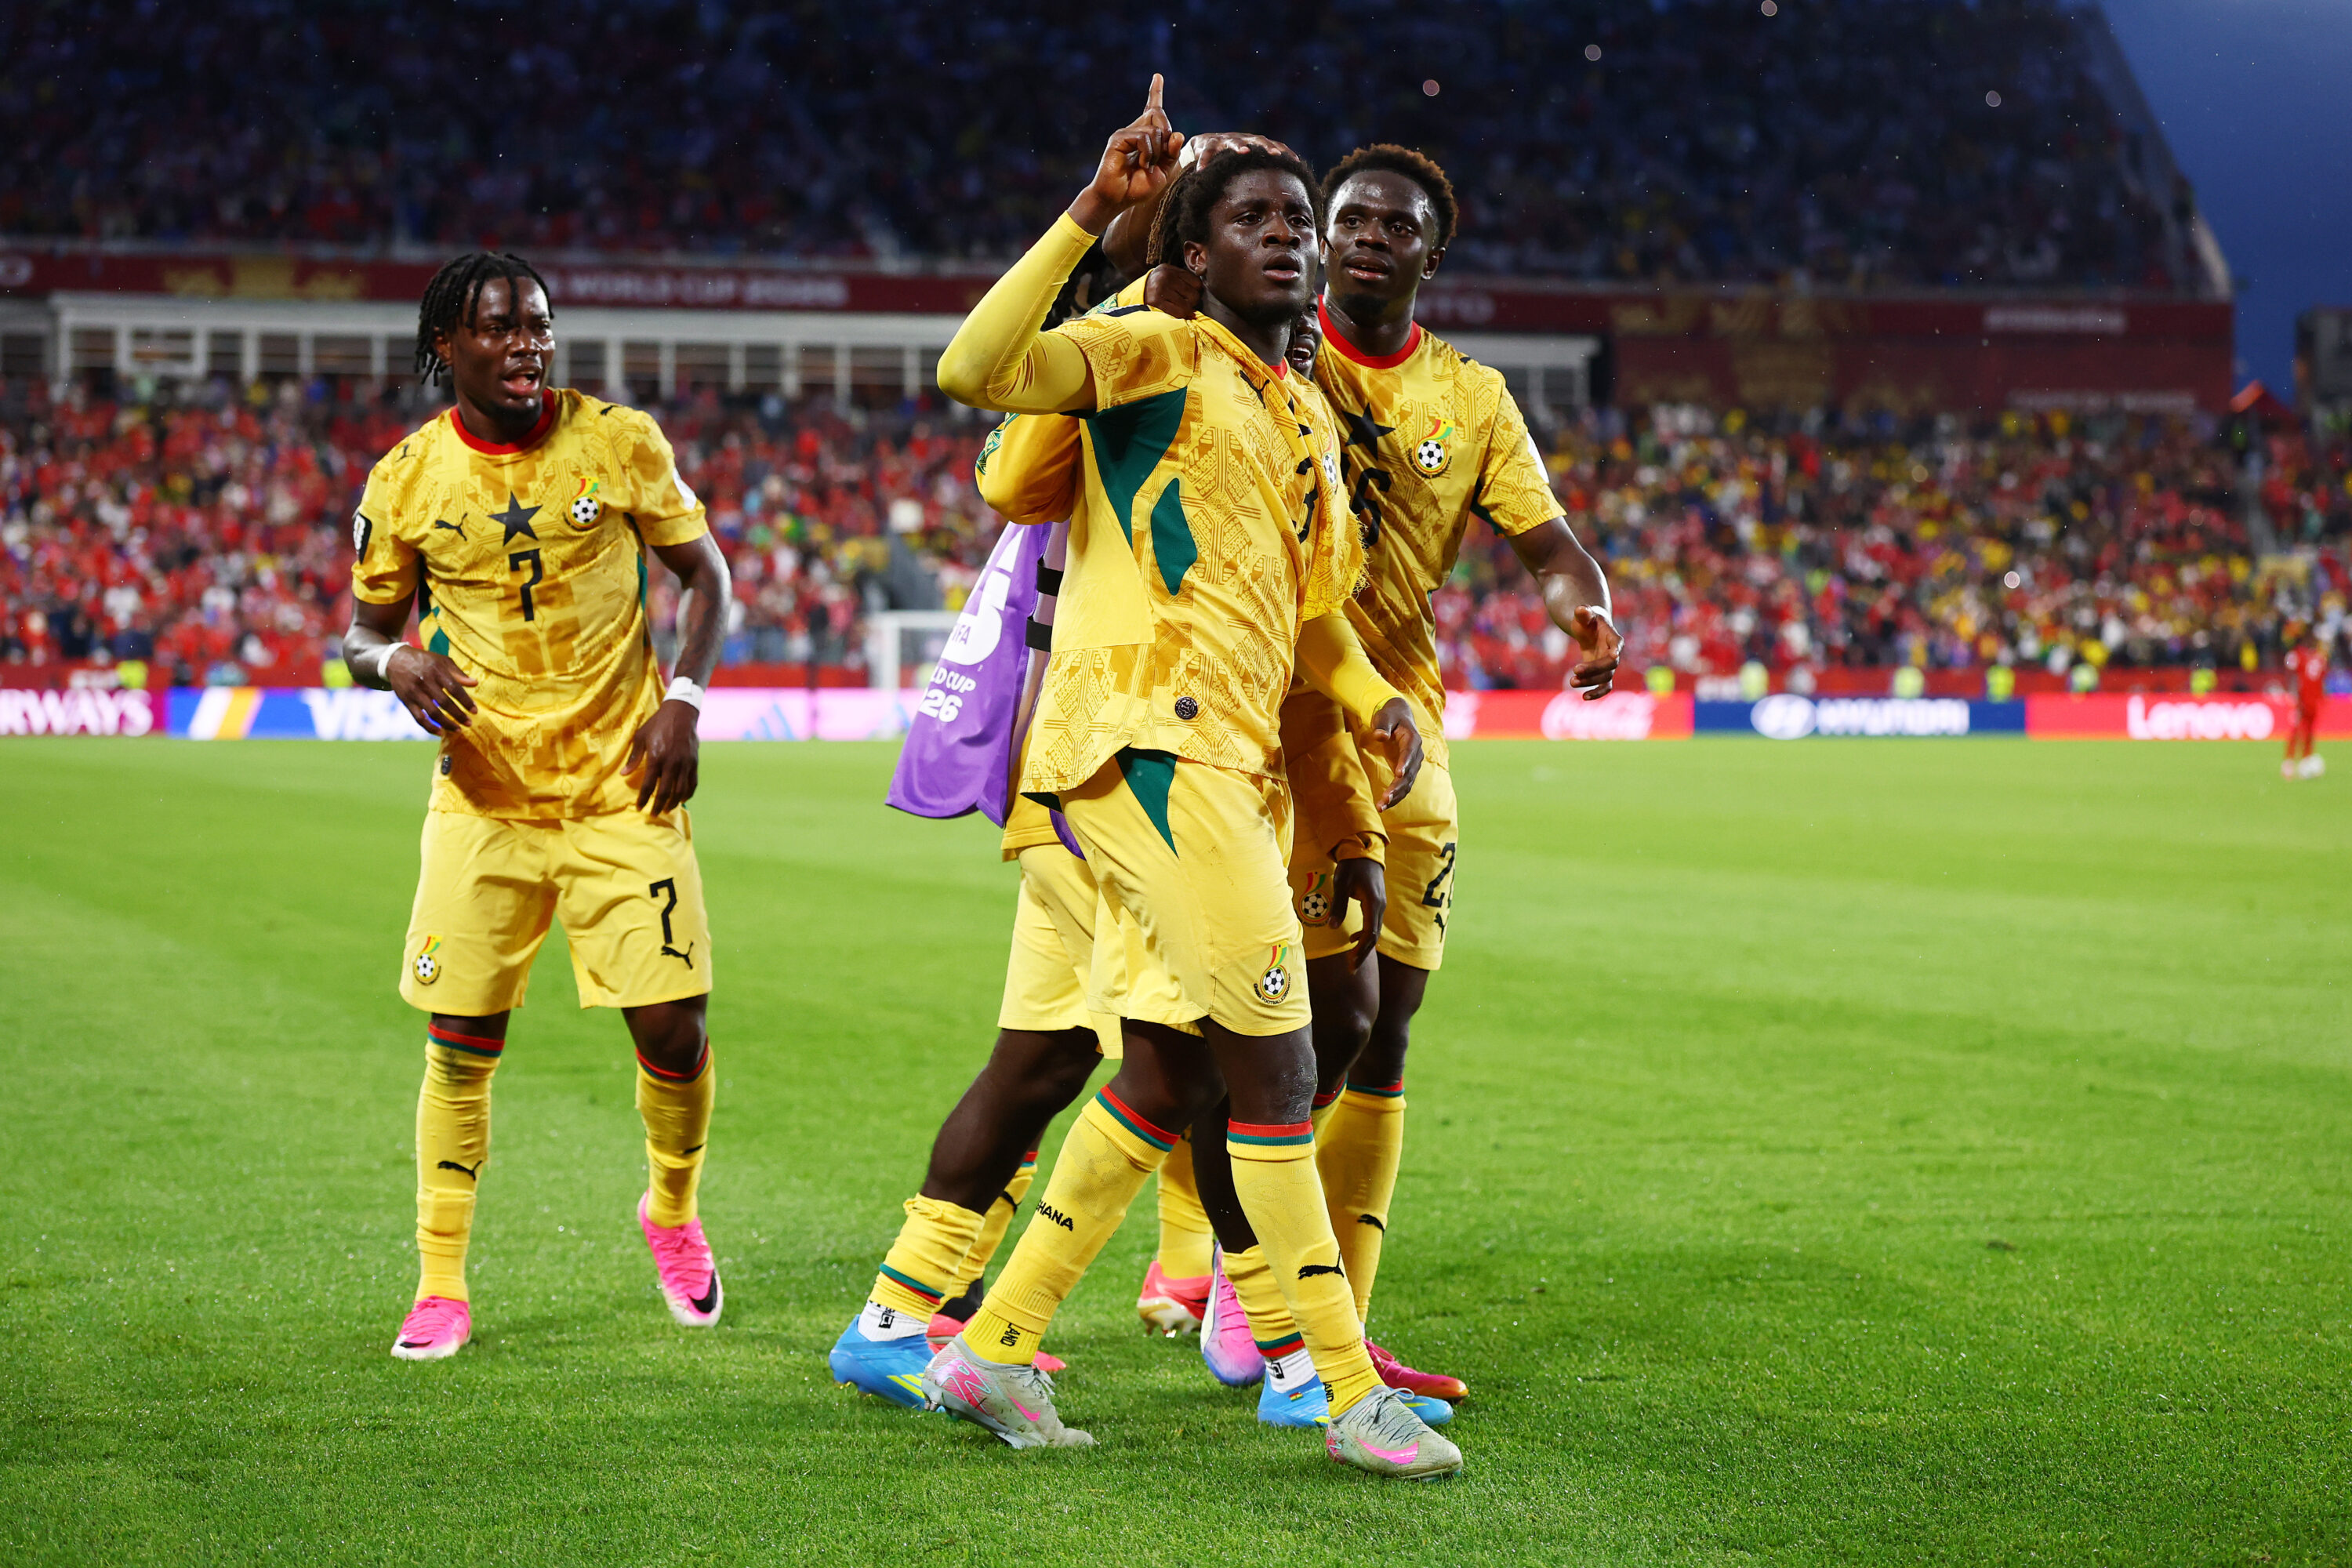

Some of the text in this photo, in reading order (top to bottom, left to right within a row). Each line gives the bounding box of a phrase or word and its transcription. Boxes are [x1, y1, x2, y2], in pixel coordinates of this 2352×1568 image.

[509, 549, 543, 622] 7
[946, 671, 977, 694] CUP
[2126, 694, 2274, 740] Lenovo
[1422, 842, 1455, 908] 2
[649, 877, 678, 944] 7
